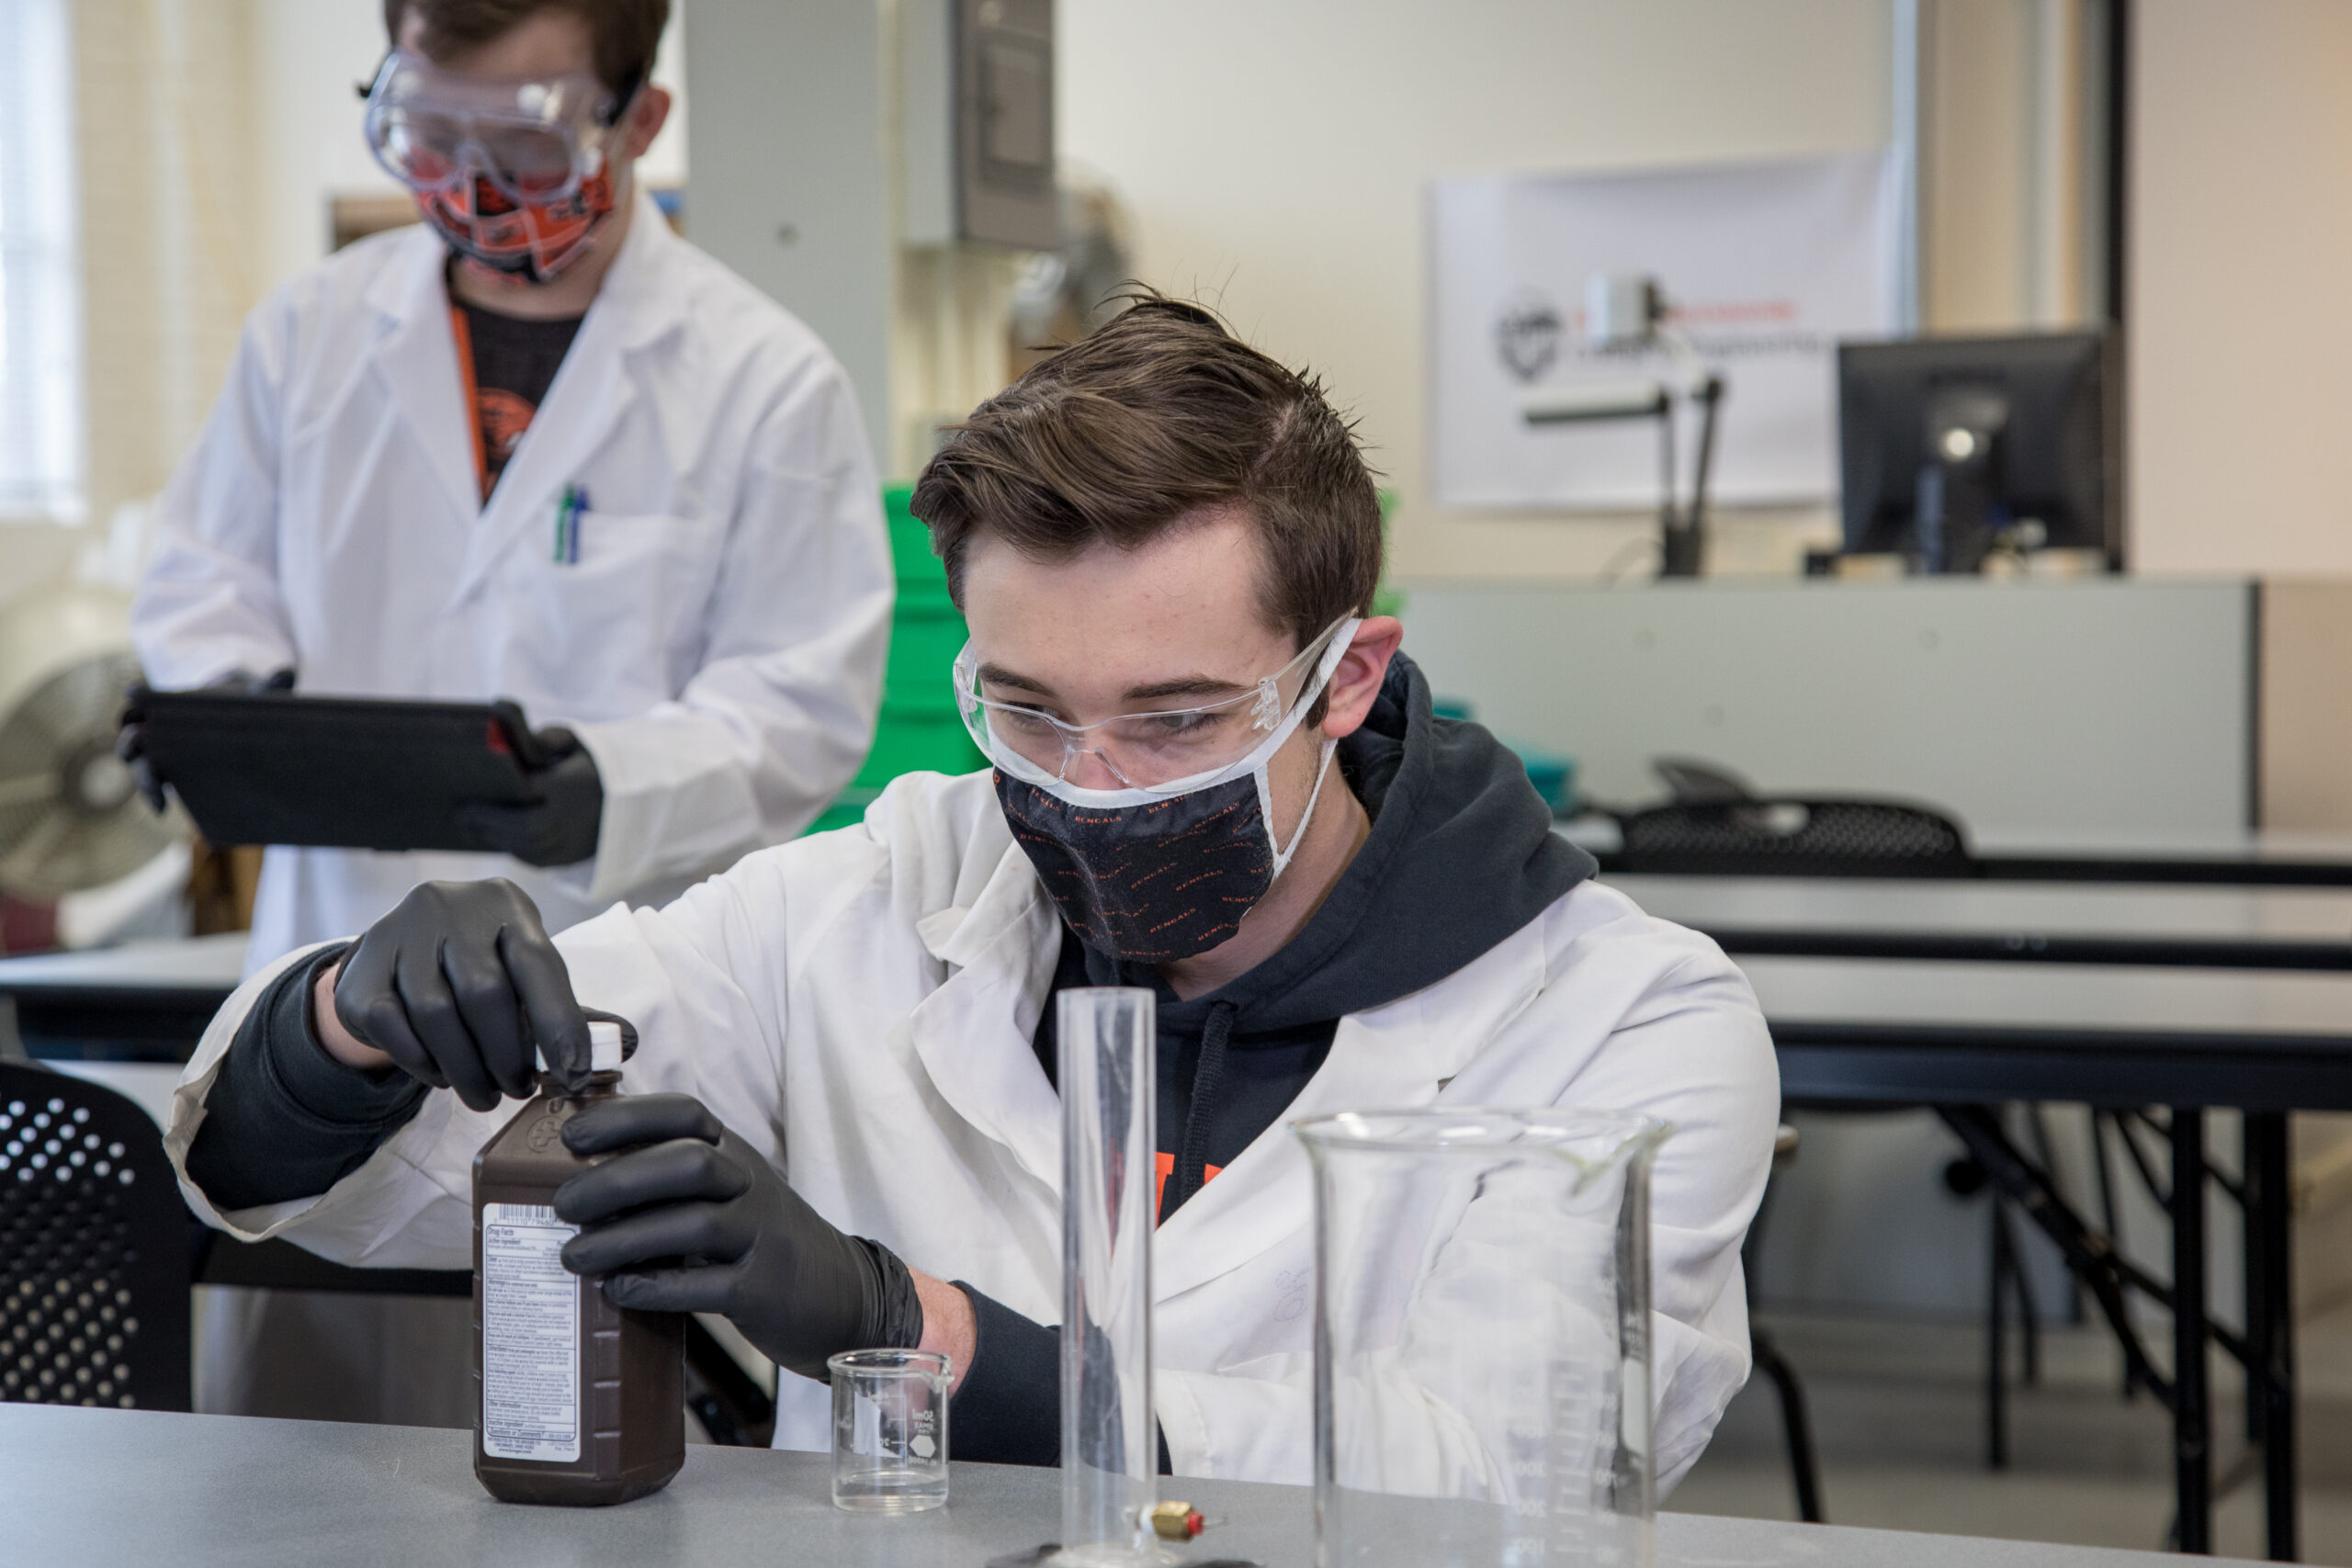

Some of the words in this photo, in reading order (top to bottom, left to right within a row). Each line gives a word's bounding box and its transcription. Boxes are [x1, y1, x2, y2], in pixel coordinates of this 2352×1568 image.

[1074, 815, 1122, 824] BENGALS
[1193, 801, 1240, 829] BENGALS
[1131, 862, 1176, 889] BENGALS
[1176, 869, 1224, 892] BENGALS
[1149, 907, 1196, 933] BENGALS
[487, 1226, 500, 1237] Drug
[501, 1228, 514, 1236] Facts
